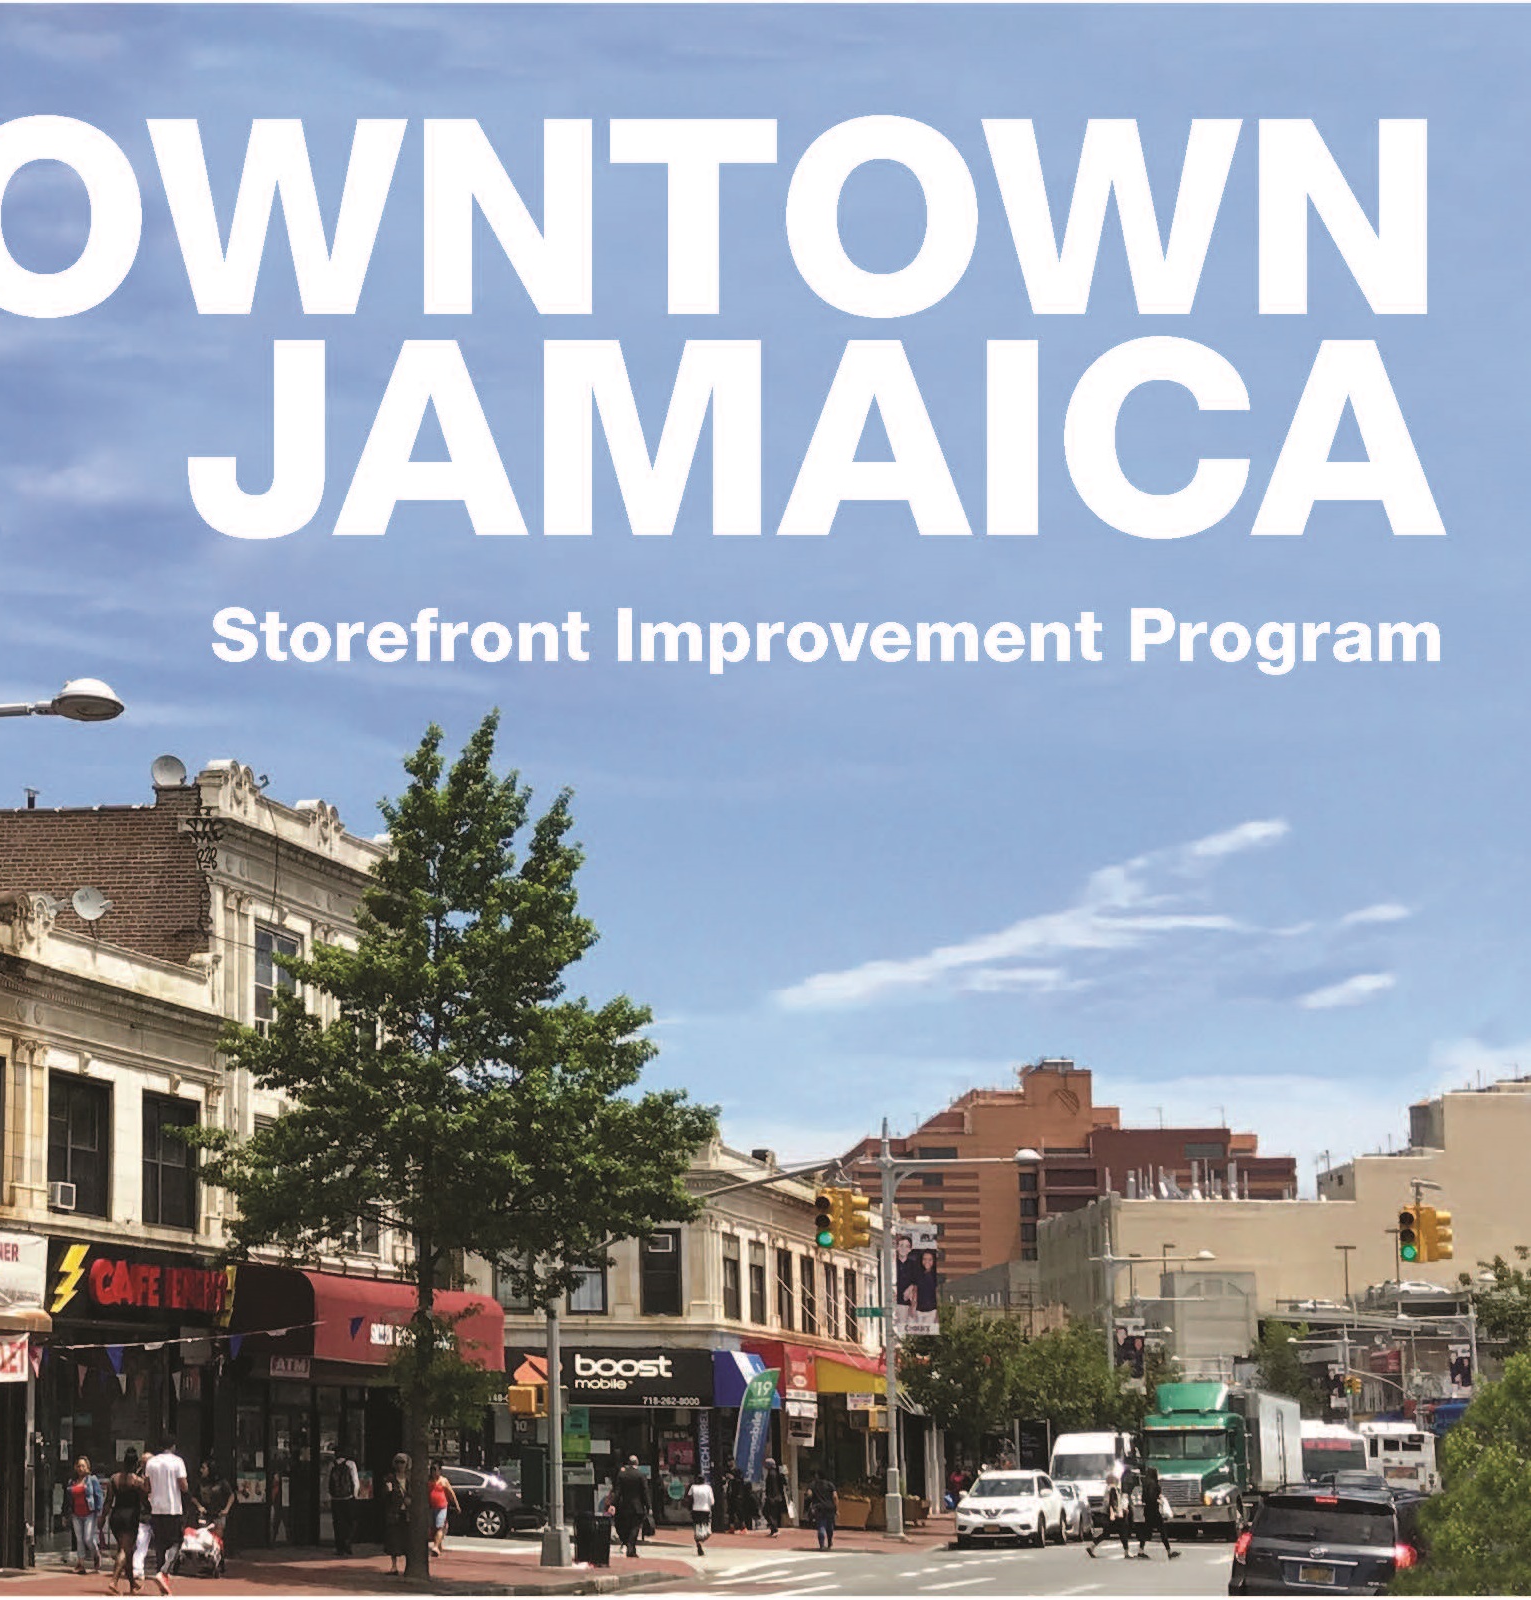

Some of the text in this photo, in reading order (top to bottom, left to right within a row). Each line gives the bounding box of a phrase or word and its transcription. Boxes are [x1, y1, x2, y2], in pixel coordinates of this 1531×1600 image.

[88, 1258, 162, 1308] CAFE
[274, 1357, 309, 1373] ATM
[574, 1353, 673, 1378] boost
[574, 1377, 628, 1390] mobile
